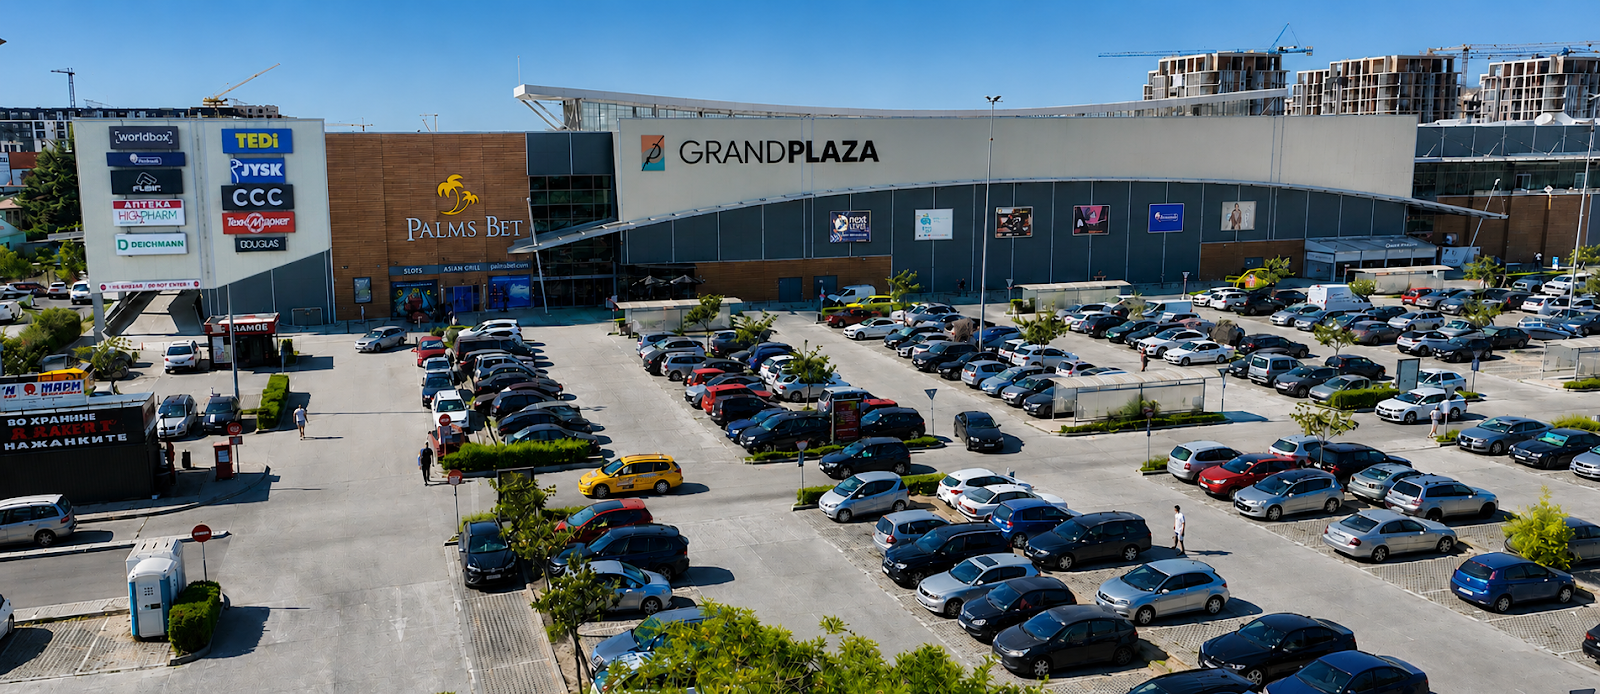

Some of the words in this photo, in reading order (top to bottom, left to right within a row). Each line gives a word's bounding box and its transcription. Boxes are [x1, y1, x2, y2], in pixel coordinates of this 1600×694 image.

[119, 132, 170, 143] worldbox
[235, 132, 279, 149] TEDi
[679, 139, 880, 165] GRANDPLAZA
[240, 163, 283, 177] JYSK
[232, 188, 283, 206] CCC
[124, 201, 171, 209] АПТЕКА
[131, 239, 184, 249] DEICHMANN
[240, 239, 280, 249] DOUGLAS
[403, 267, 423, 275] SLOTS
[443, 265, 463, 273] ASIAN
[464, 264, 480, 272] GRILL
